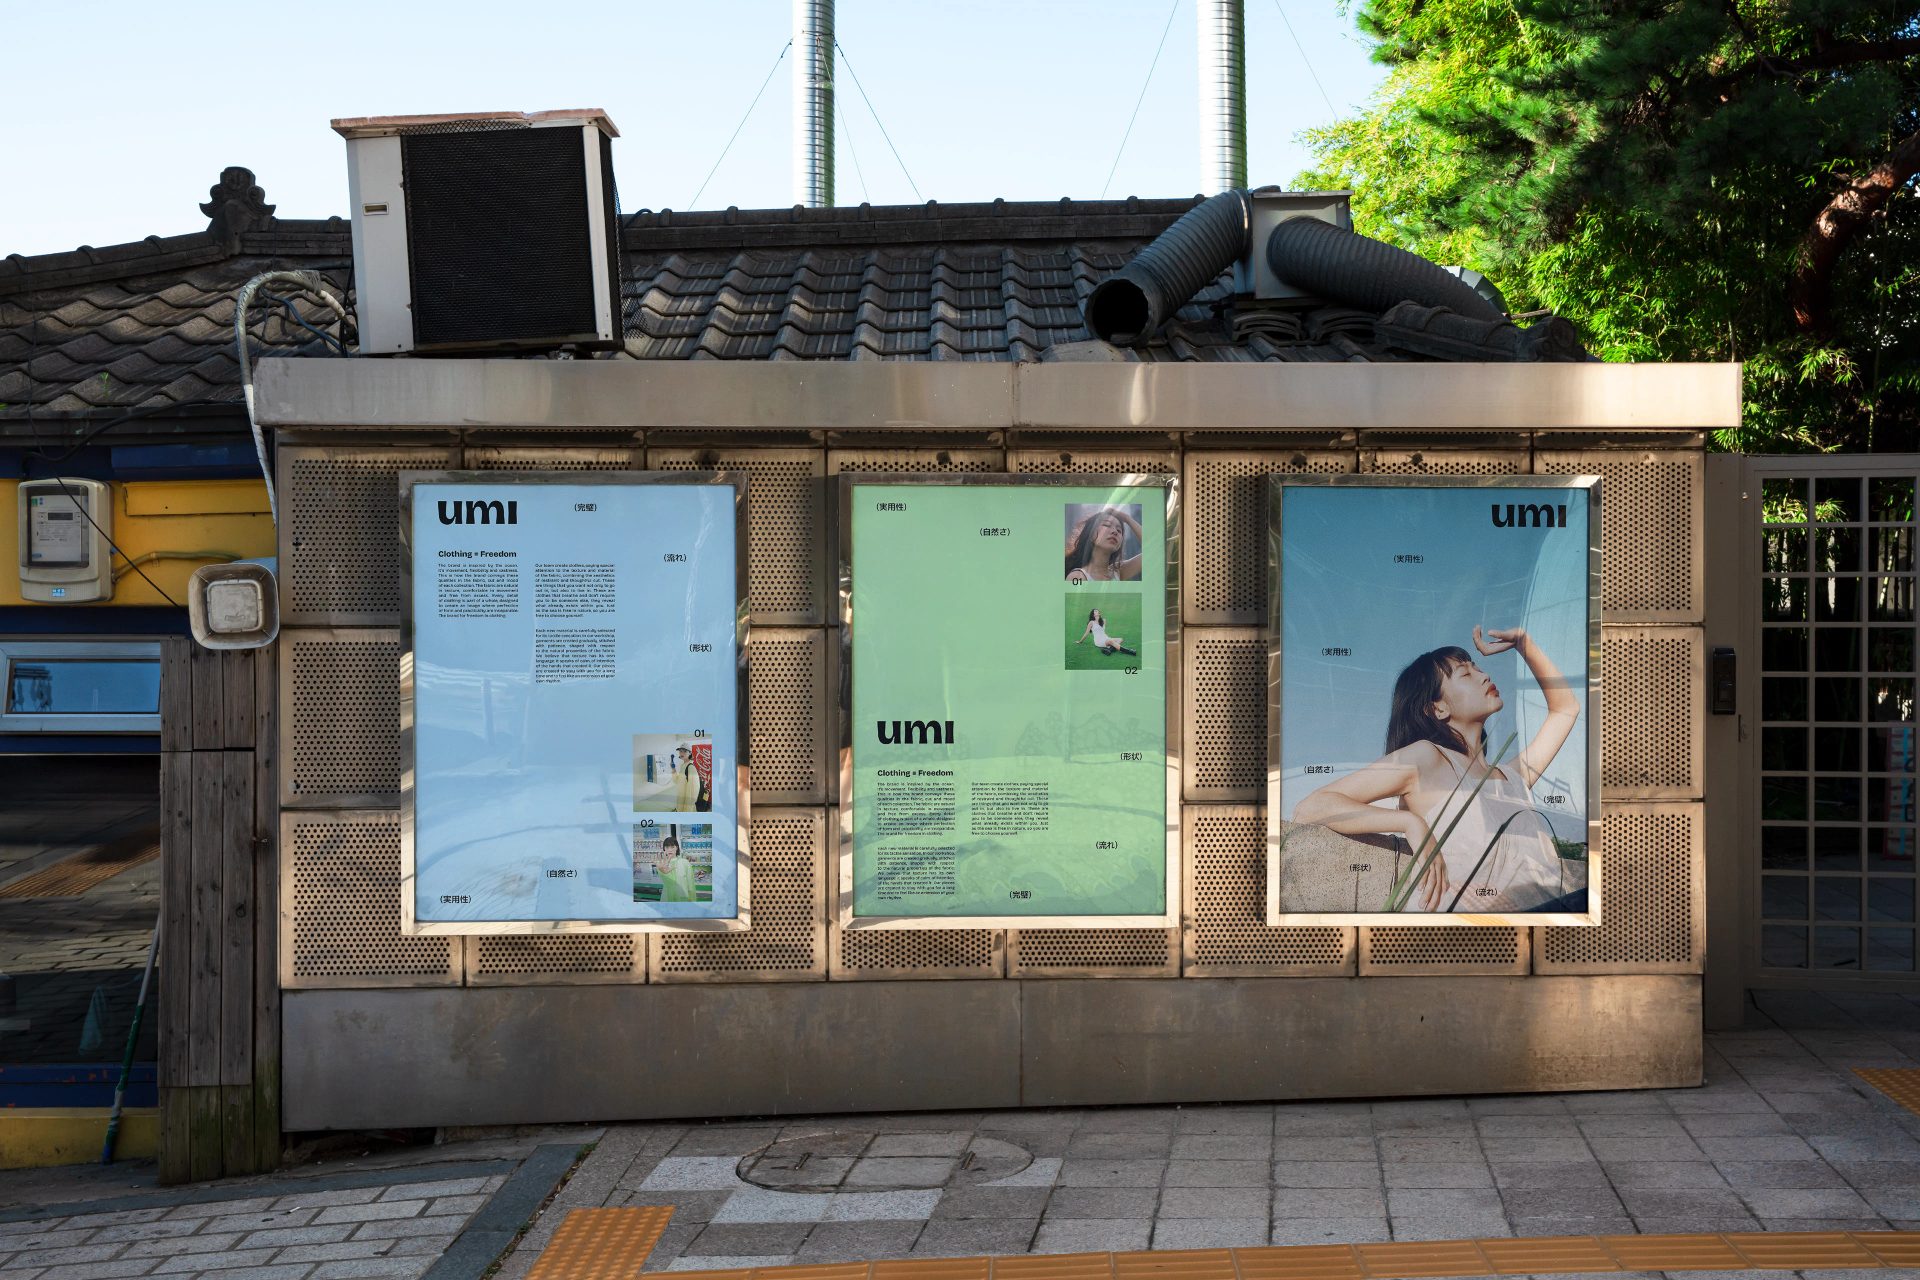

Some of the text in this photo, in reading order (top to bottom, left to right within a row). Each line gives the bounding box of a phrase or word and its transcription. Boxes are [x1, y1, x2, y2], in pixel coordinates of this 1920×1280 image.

[1072, 577, 1083, 586] 01
[1125, 665, 1137, 674] 02
[694, 729, 705, 738] 01
[640, 819, 654, 828] 02
